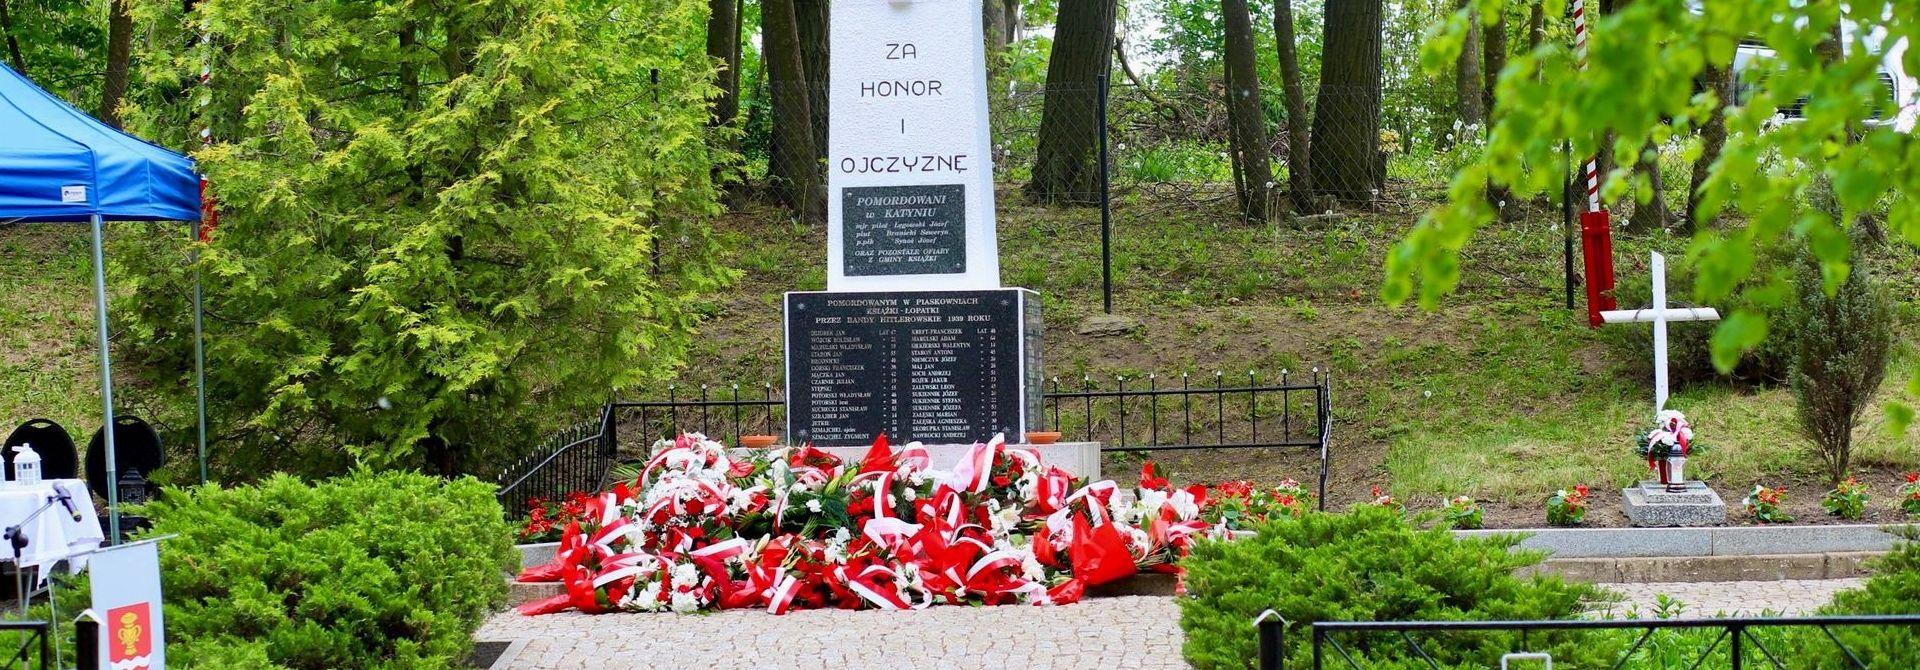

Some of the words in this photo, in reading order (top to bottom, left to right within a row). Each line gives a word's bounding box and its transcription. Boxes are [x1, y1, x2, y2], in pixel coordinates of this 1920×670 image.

[886, 44, 916, 59] ZA
[861, 81, 942, 97] HONOR
[901, 118, 905, 134] I
[841, 155, 967, 174] OJCZYZNĘ
[857, 195, 946, 206] POMORDOWANI
[884, 208, 936, 218] KATYNIU
[828, 299, 897, 307] POMORDOWANYM
[880, 315, 941, 323] HITLEROWSKIE
